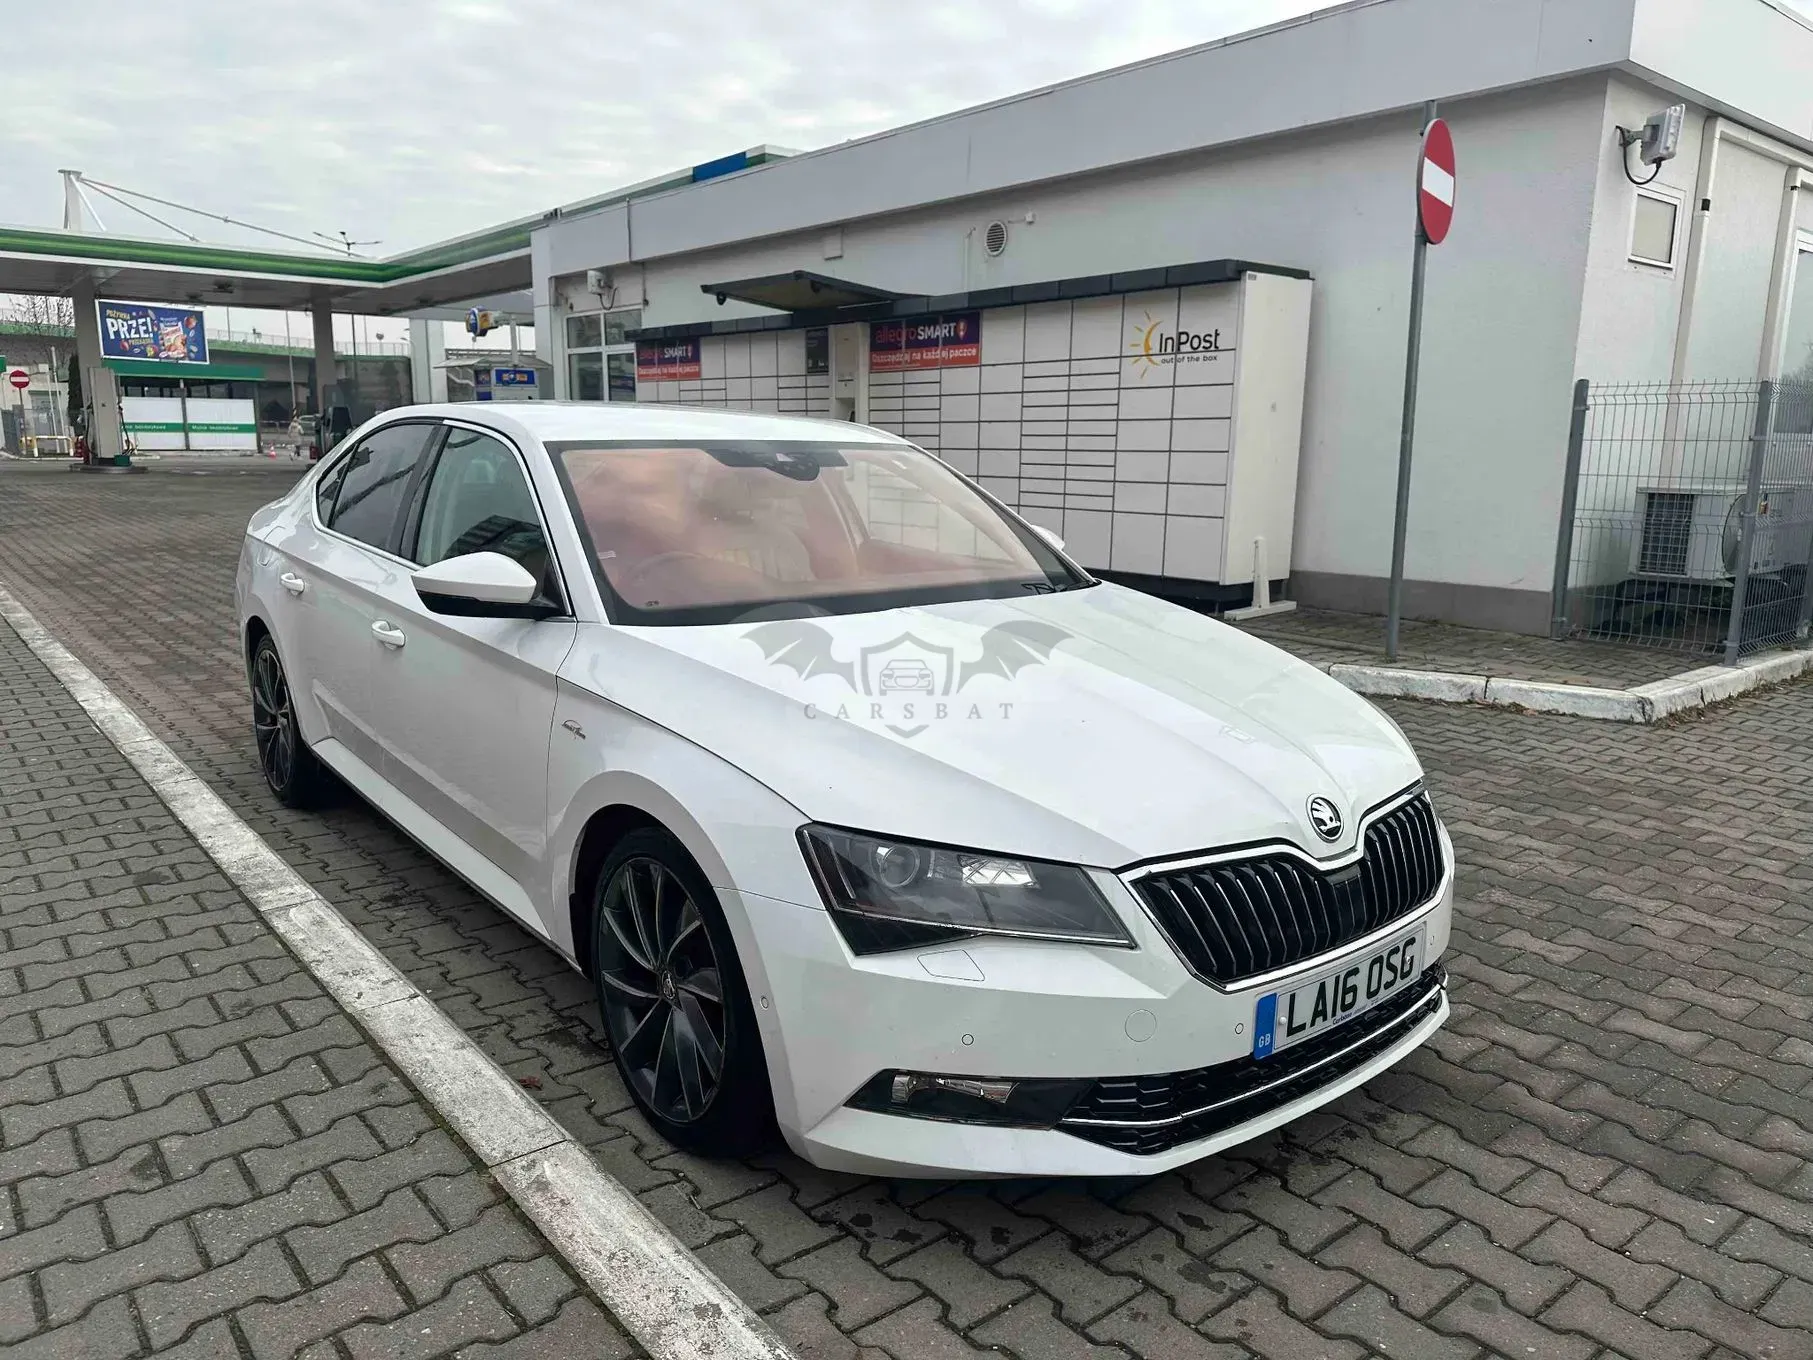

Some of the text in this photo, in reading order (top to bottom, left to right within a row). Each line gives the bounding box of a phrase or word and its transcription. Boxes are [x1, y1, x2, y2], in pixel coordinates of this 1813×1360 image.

[106, 317, 153, 340] PRZE!
[1159, 329, 1220, 352] InPost
[912, 352, 920, 360] na
[950, 348, 976, 358] paczce
[1286, 936, 1416, 1038] LA16 OSG
[1258, 1032, 1271, 1048] GB
